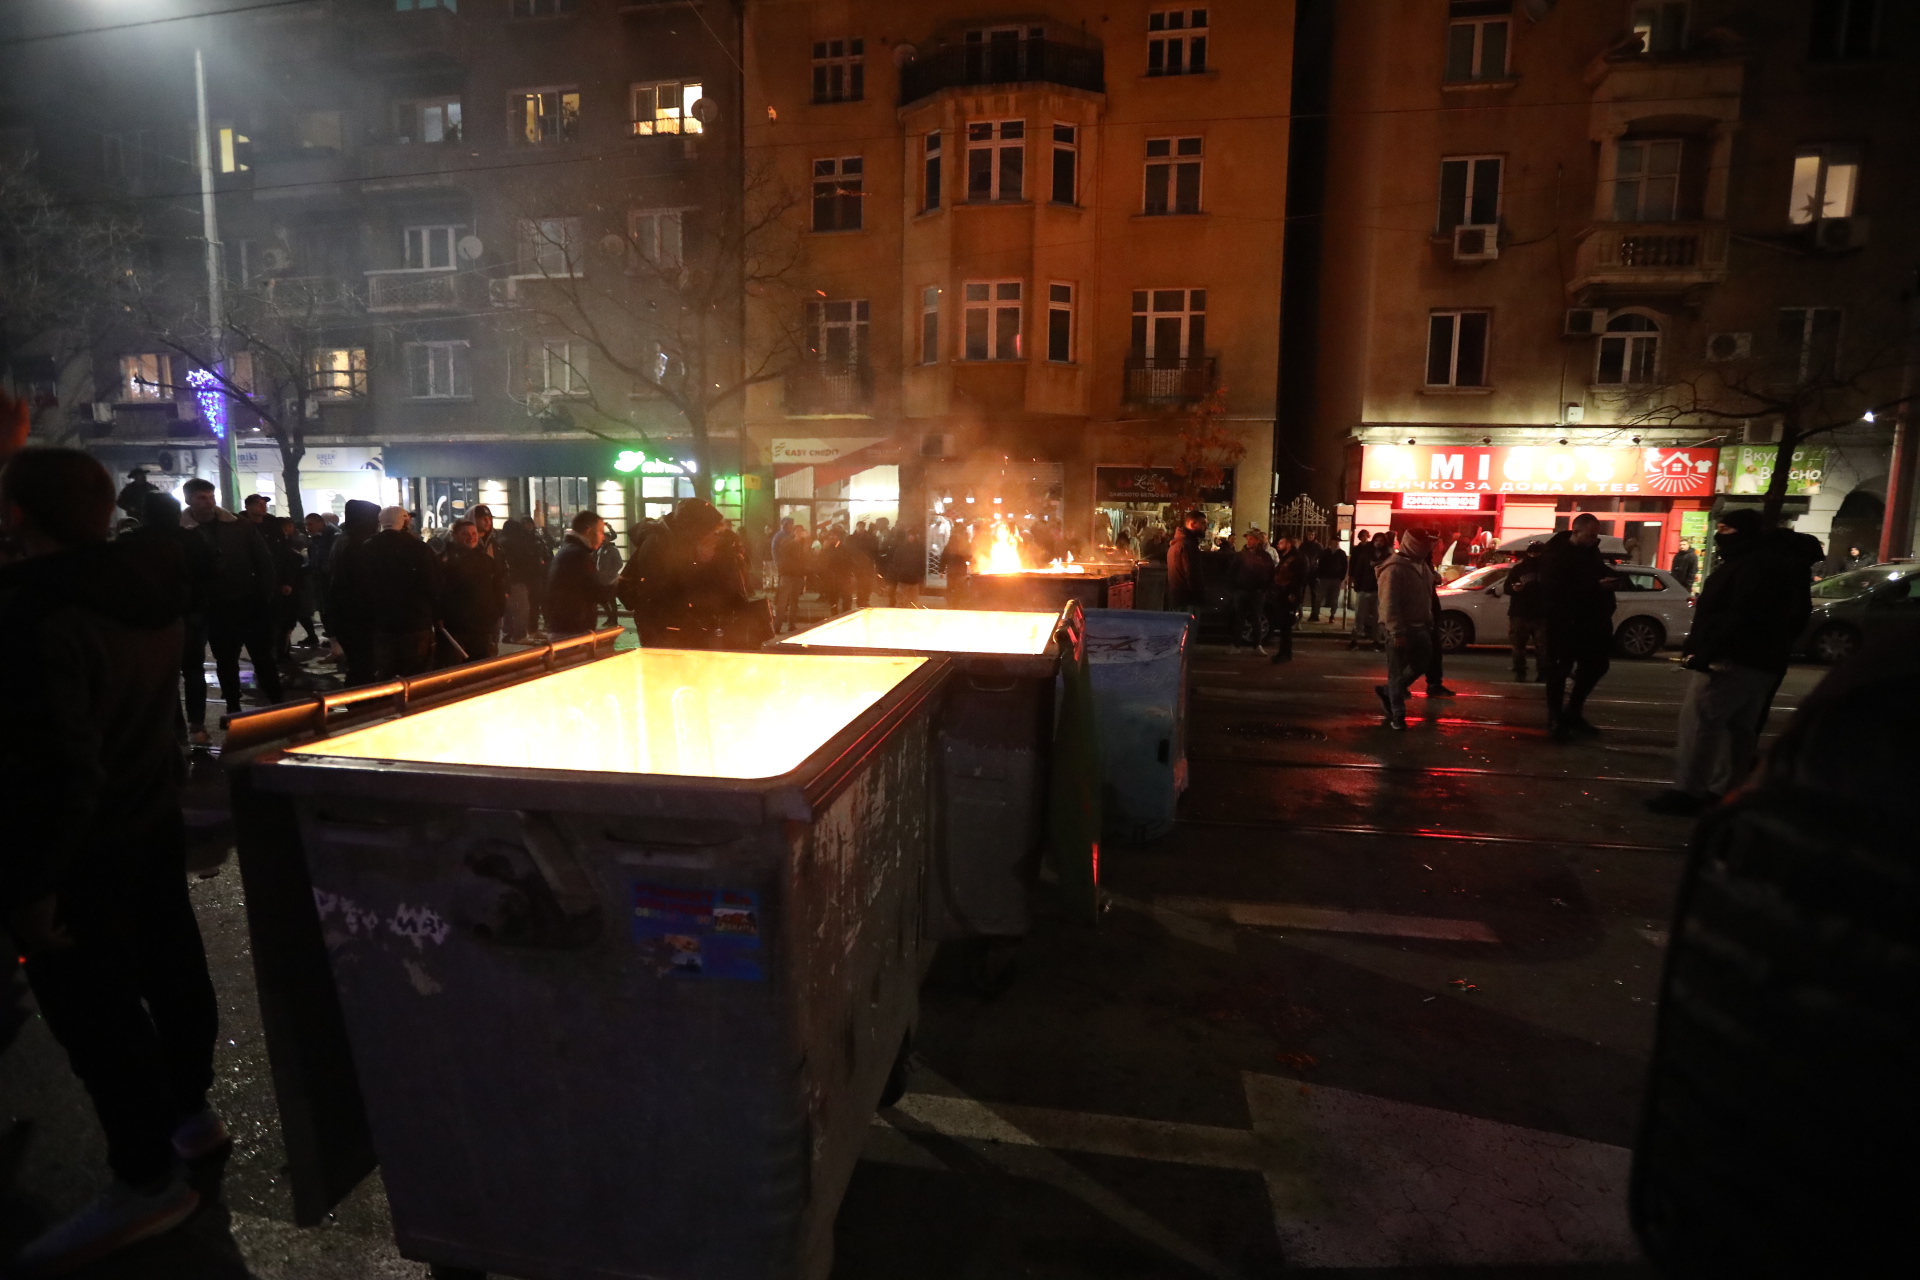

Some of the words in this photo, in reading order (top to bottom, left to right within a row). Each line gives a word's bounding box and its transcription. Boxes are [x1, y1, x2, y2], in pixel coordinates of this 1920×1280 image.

[809, 449, 839, 457] CREDIT
[1743, 448, 1804, 466] Вкусо
[1389, 453, 1616, 482] AMIGOS
[1760, 466, 1822, 480] Всно
[1369, 481, 1455, 490] ВСИЧКО
[1464, 482, 1491, 491] ЗА
[1499, 482, 1564, 492] ДОМА
[1573, 483, 1587, 492] И
[1596, 483, 1640, 493] ТЕБ
